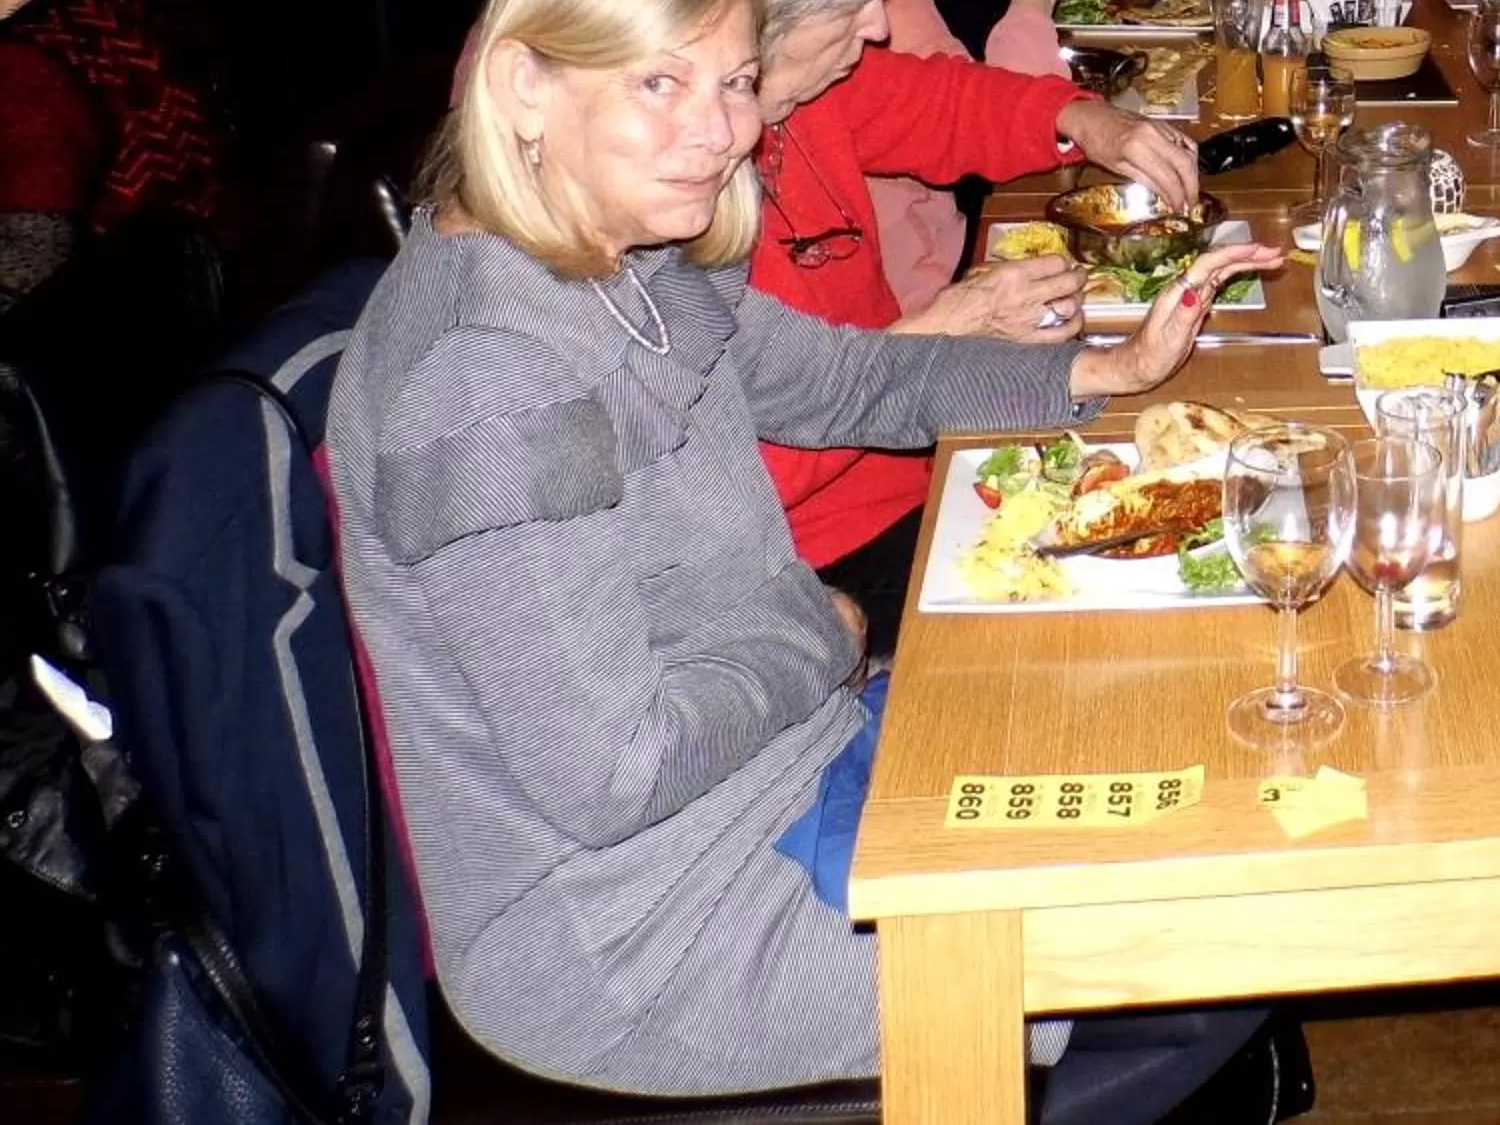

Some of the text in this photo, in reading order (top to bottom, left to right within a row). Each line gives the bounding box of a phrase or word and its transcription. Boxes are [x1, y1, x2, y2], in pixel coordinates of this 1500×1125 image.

[955, 783, 985, 820] 860
[1006, 783, 1035, 820] 859
[1056, 782, 1084, 818] 858
[1107, 782, 1133, 817] 857
